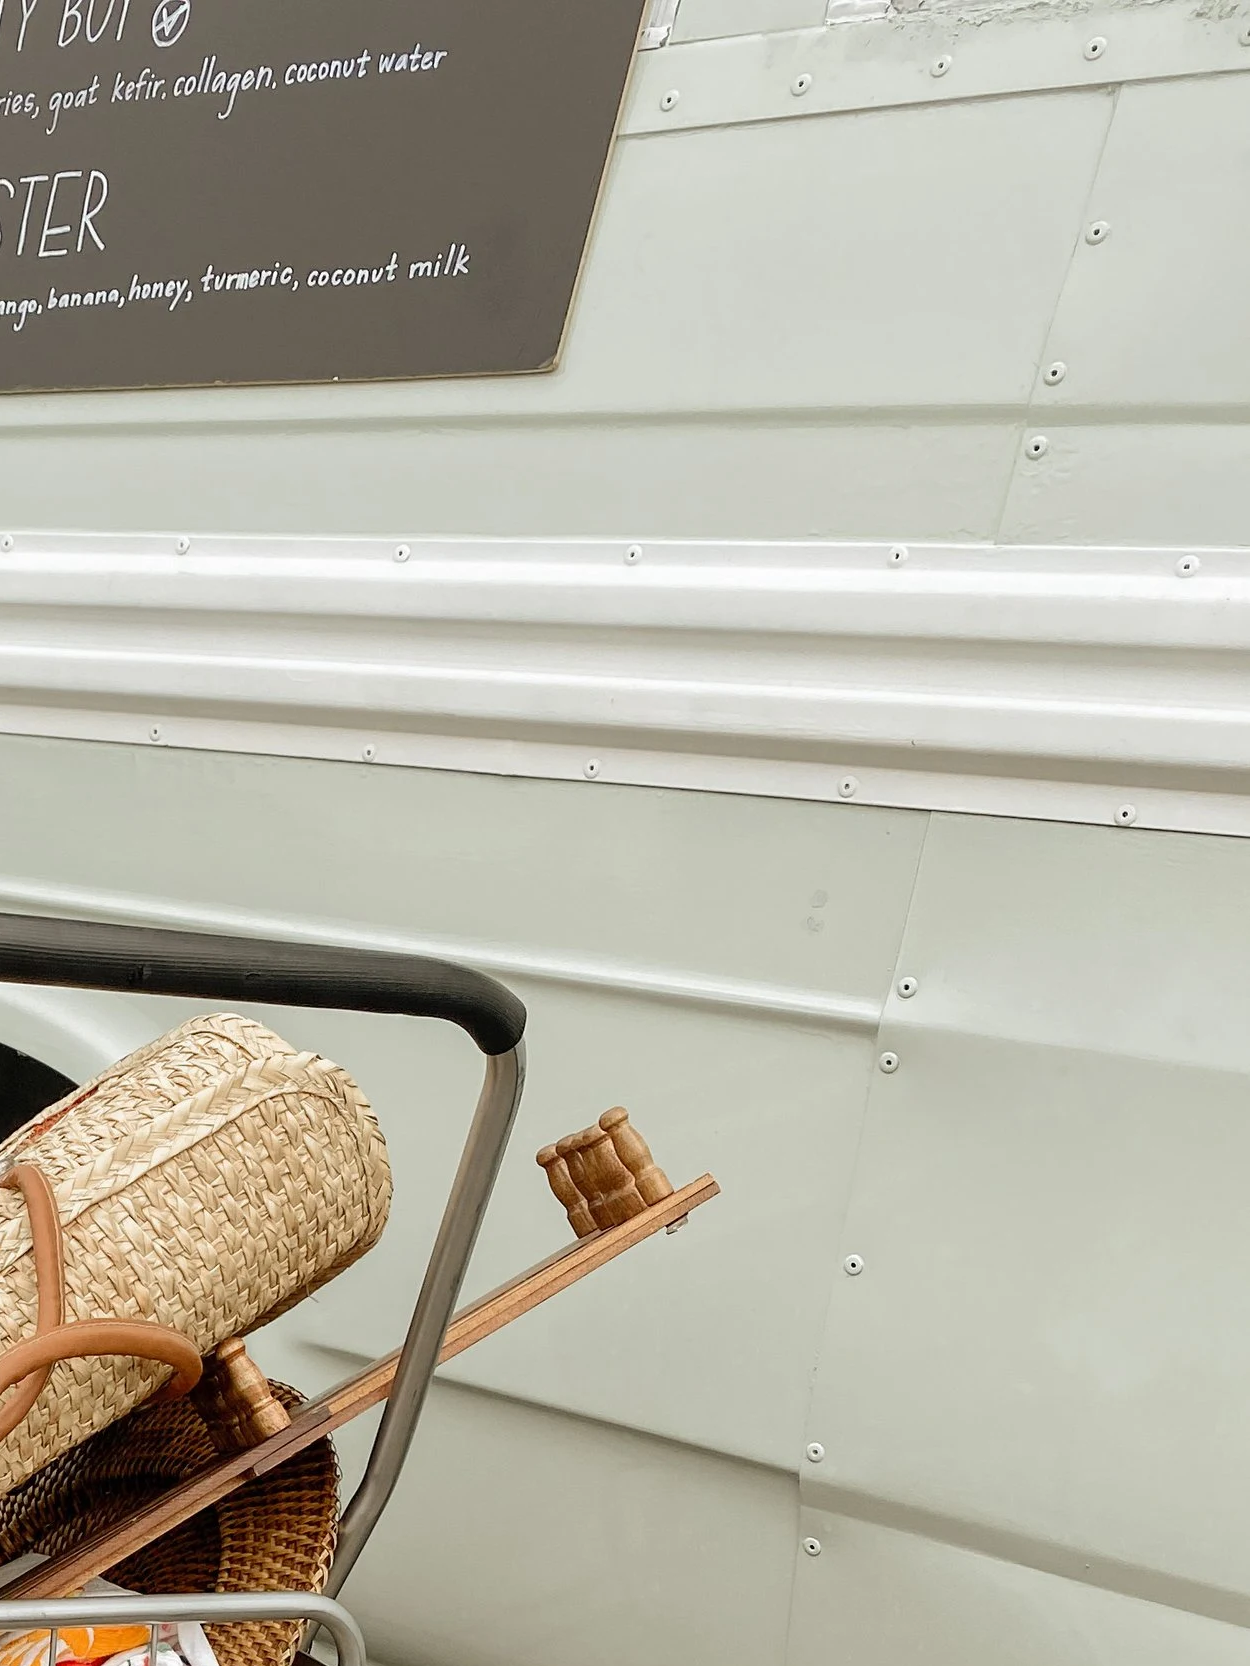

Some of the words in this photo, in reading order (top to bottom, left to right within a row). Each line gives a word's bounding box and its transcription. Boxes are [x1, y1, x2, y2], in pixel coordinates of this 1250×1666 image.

[46, 74, 100, 135] goat
[284, 48, 372, 86] coconut
[378, 43, 448, 73] water
[47, 287, 126, 310] banana,
[127, 273, 194, 312] honey,
[200, 262, 300, 293] turmeric,
[306, 251, 399, 288] coconut
[408, 242, 471, 280] milk
